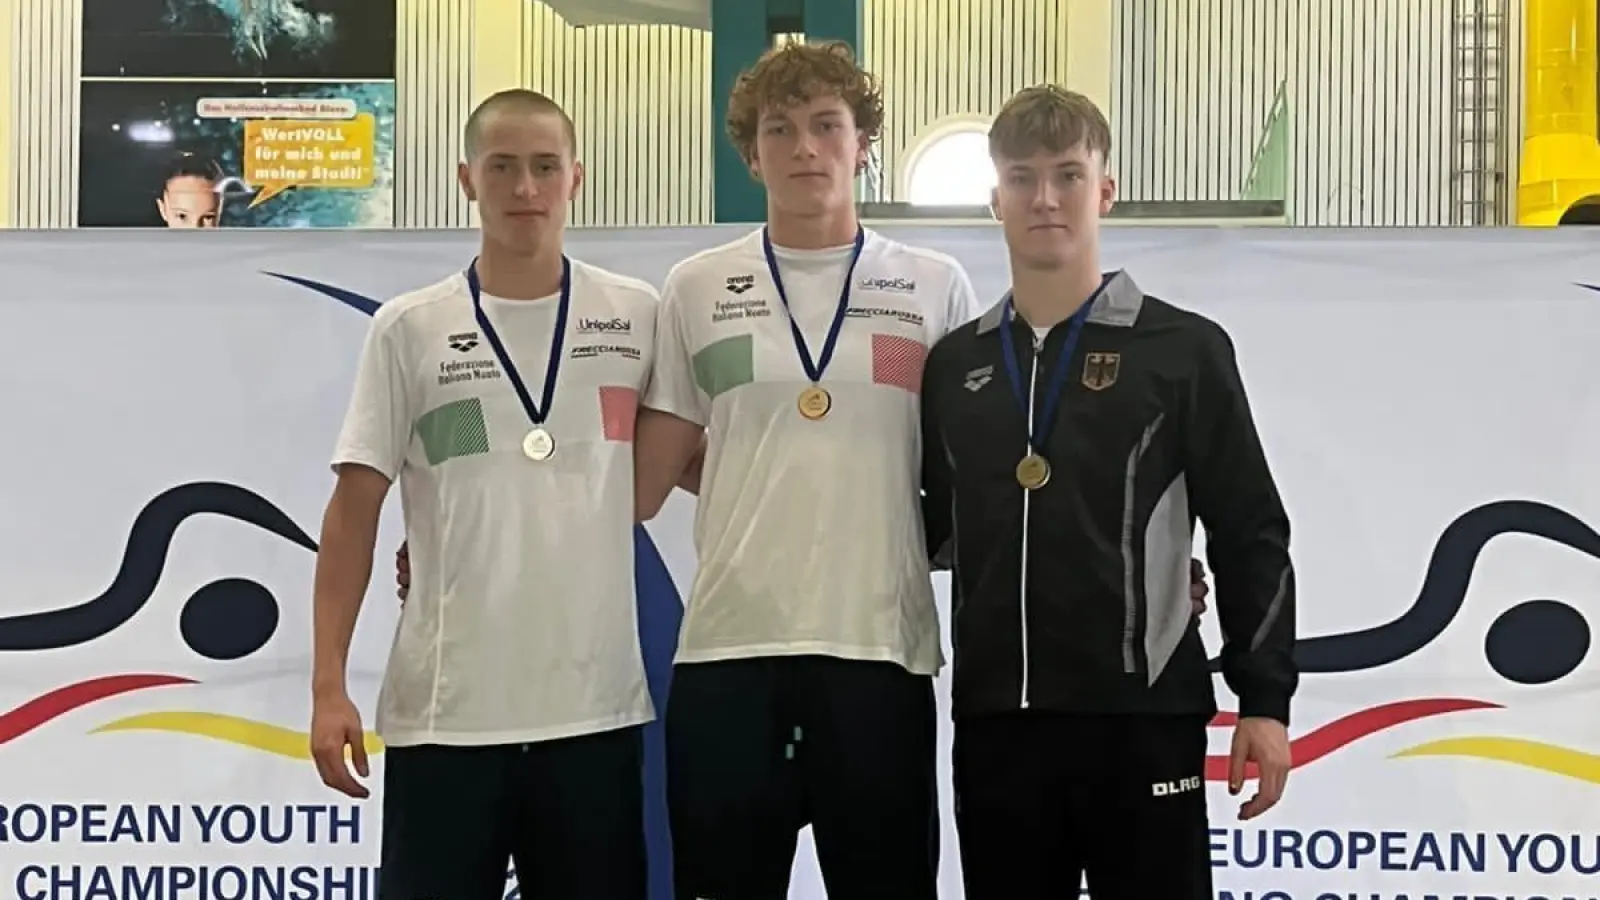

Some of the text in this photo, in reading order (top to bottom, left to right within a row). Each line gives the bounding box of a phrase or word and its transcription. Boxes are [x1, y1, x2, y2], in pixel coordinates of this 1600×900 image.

[255, 146, 362, 161] für mich und
[255, 165, 307, 179] meine
[1151, 775, 1200, 797] DLRG
[191, 804, 360, 844] YOUTH
[1209, 828, 1485, 873] EUROPEAN
[16, 865, 381, 900] CHAMPIONSHI
